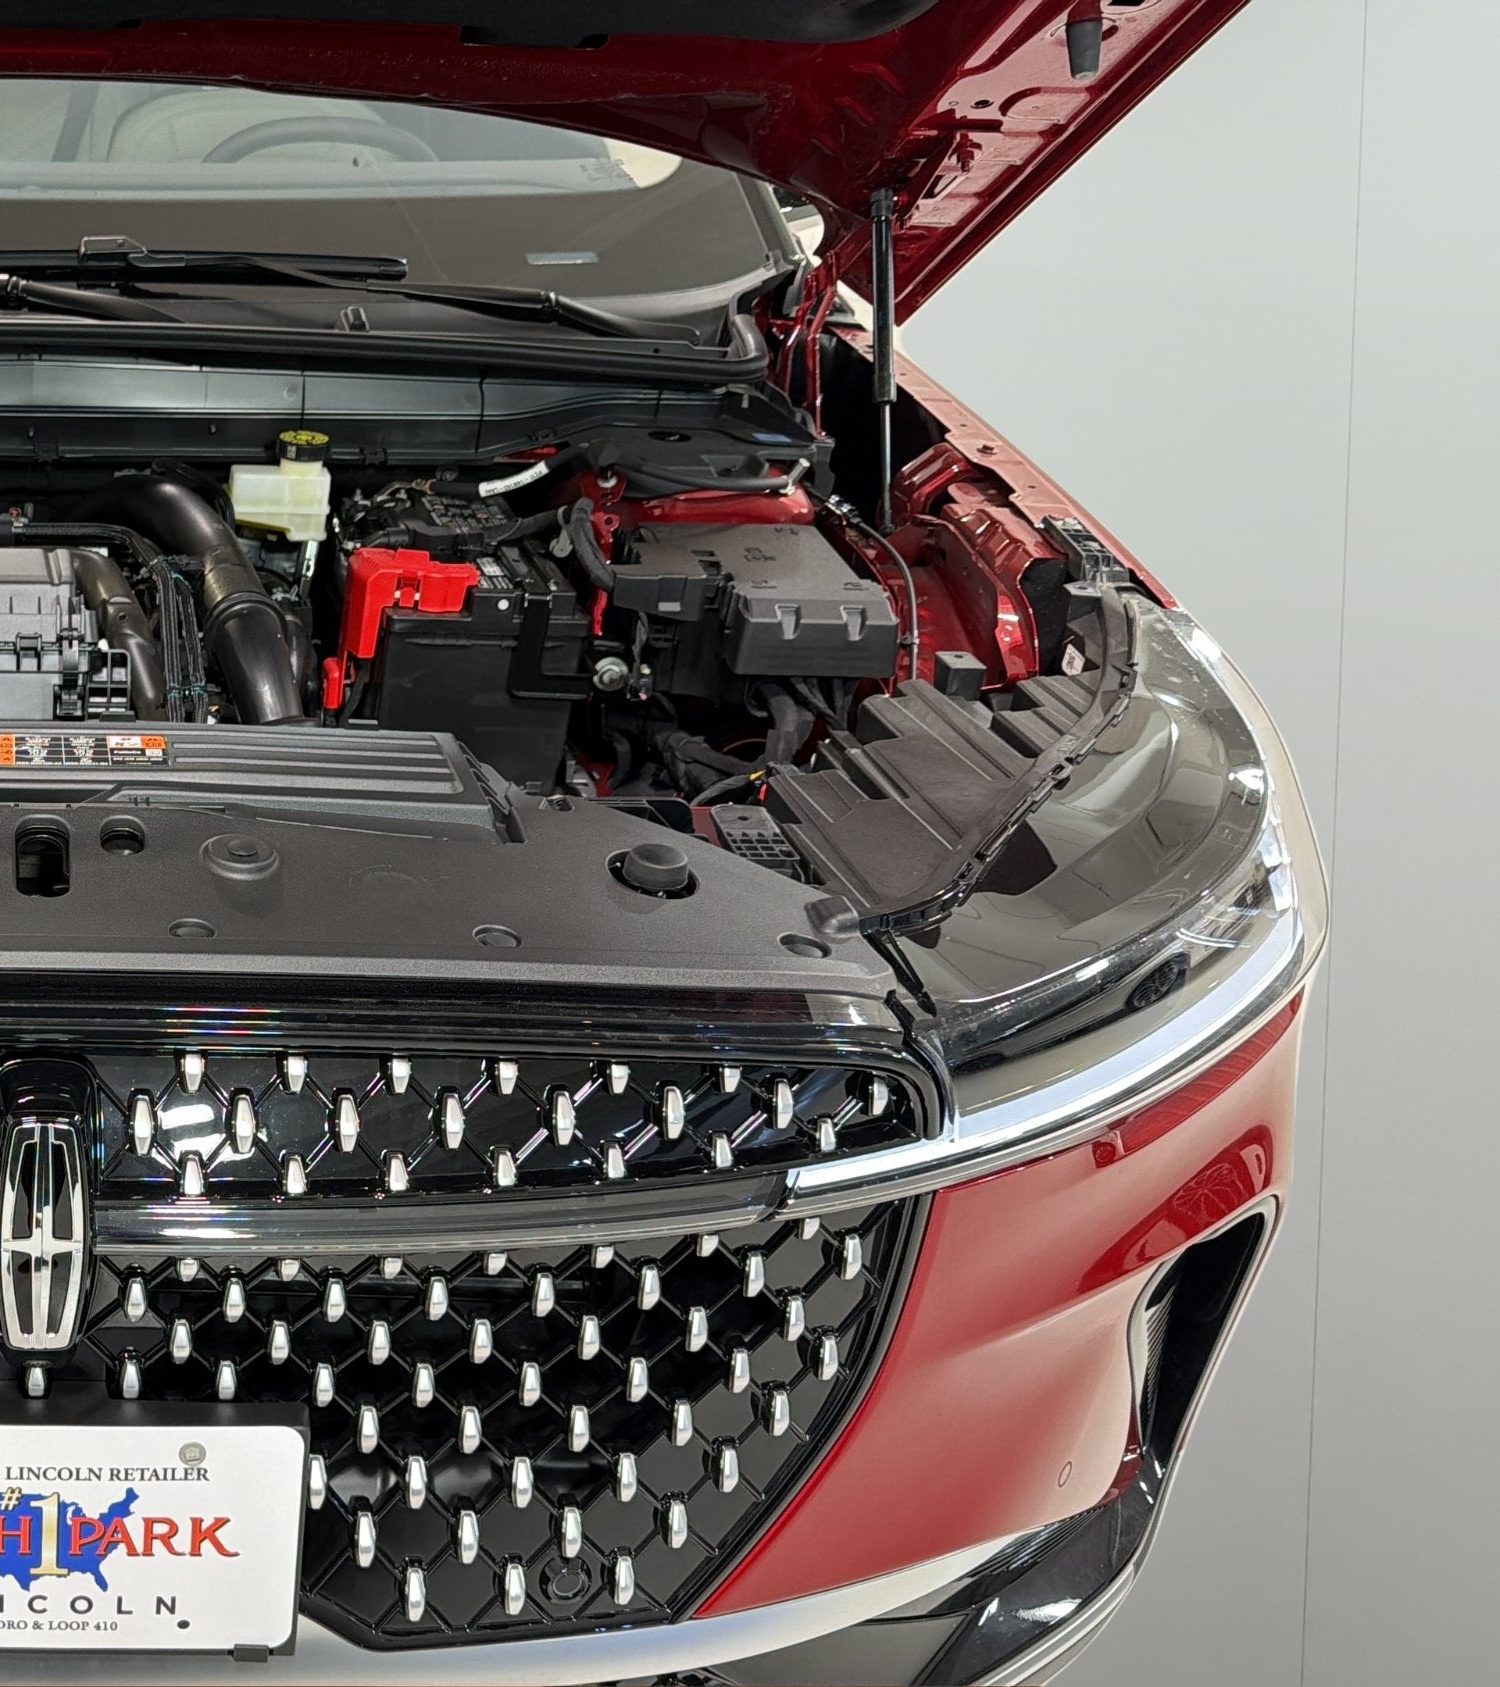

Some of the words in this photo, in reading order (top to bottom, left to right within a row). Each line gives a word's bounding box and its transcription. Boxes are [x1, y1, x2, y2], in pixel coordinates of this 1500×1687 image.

[5, 1466, 102, 1481] LINCOLN
[108, 1466, 210, 1482] RETAILER
[68, 1515, 241, 1557] PARK
[32, 1620, 43, 1631] &
[48, 1620, 91, 1631] LOOP
[93, 1621, 118, 1632] 410
